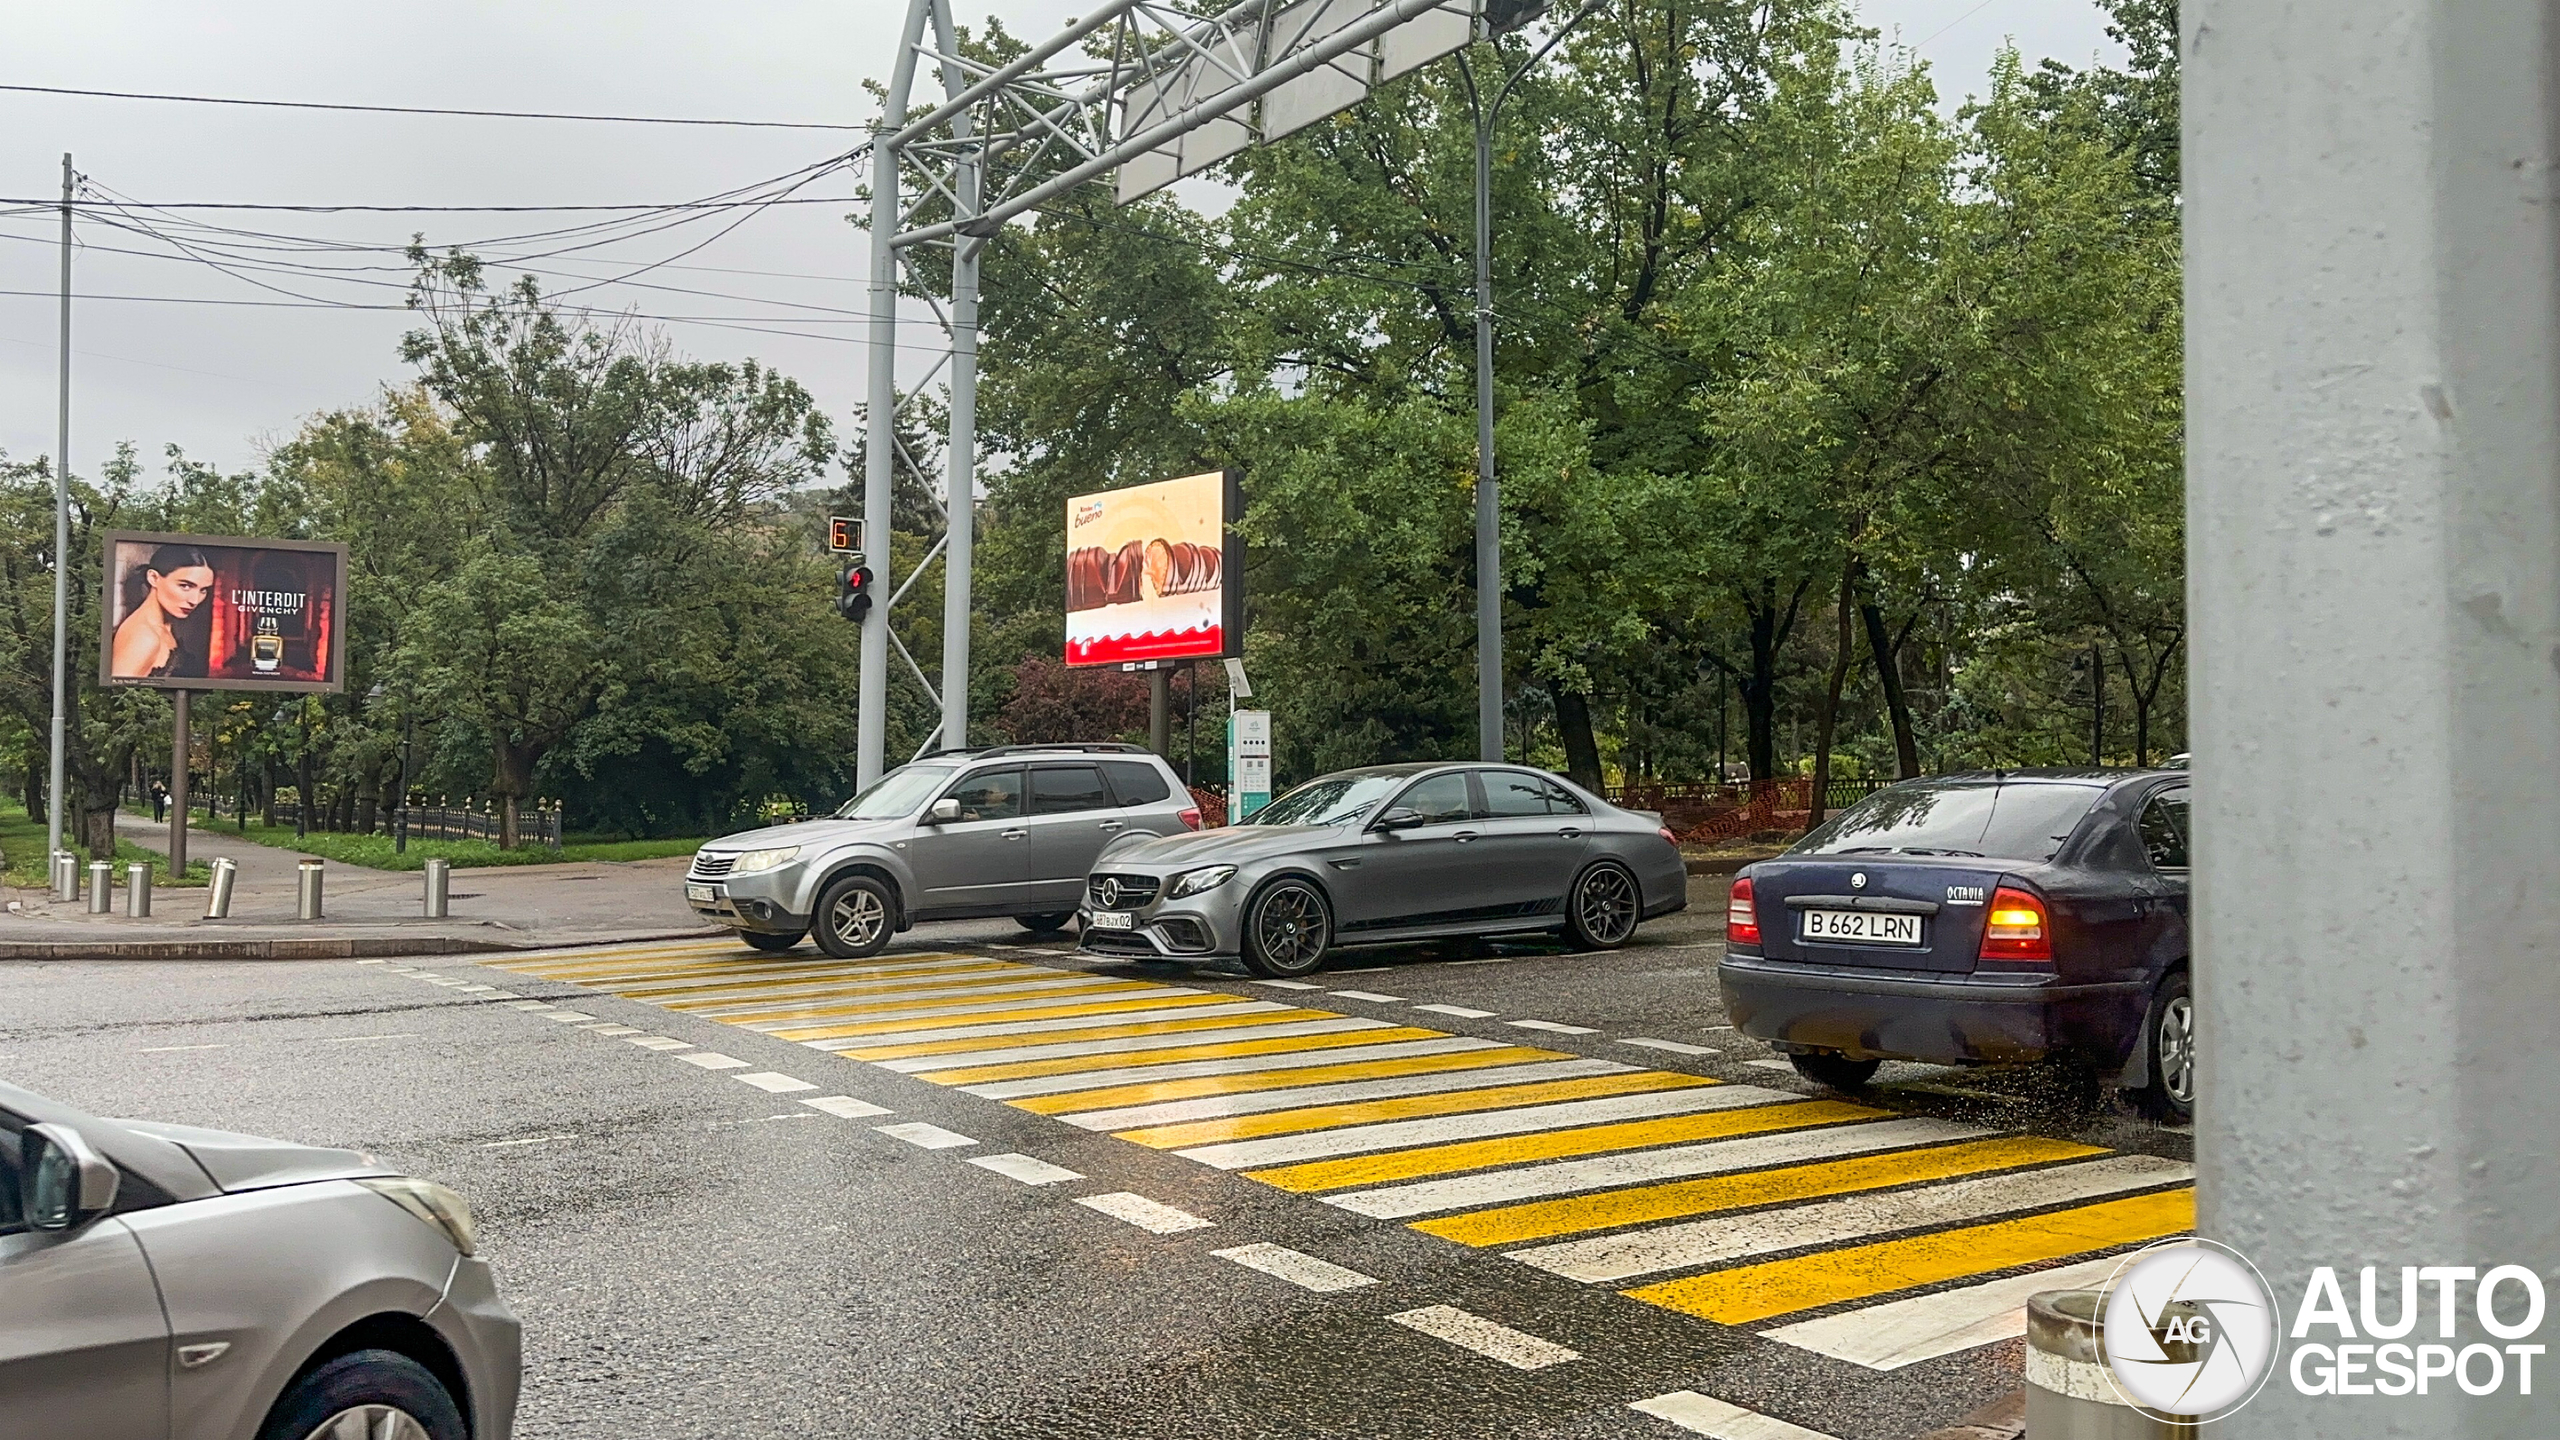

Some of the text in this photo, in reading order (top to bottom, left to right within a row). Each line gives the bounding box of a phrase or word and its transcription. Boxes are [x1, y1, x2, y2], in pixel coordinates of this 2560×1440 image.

[1074, 510, 1103, 528] bueno
[231, 589, 306, 609] L'INTERDIT
[237, 605, 299, 615] GIVENCHY
[1946, 886, 1984, 900] OCTAVIA
[1811, 913, 1914, 939] B 662 LRN
